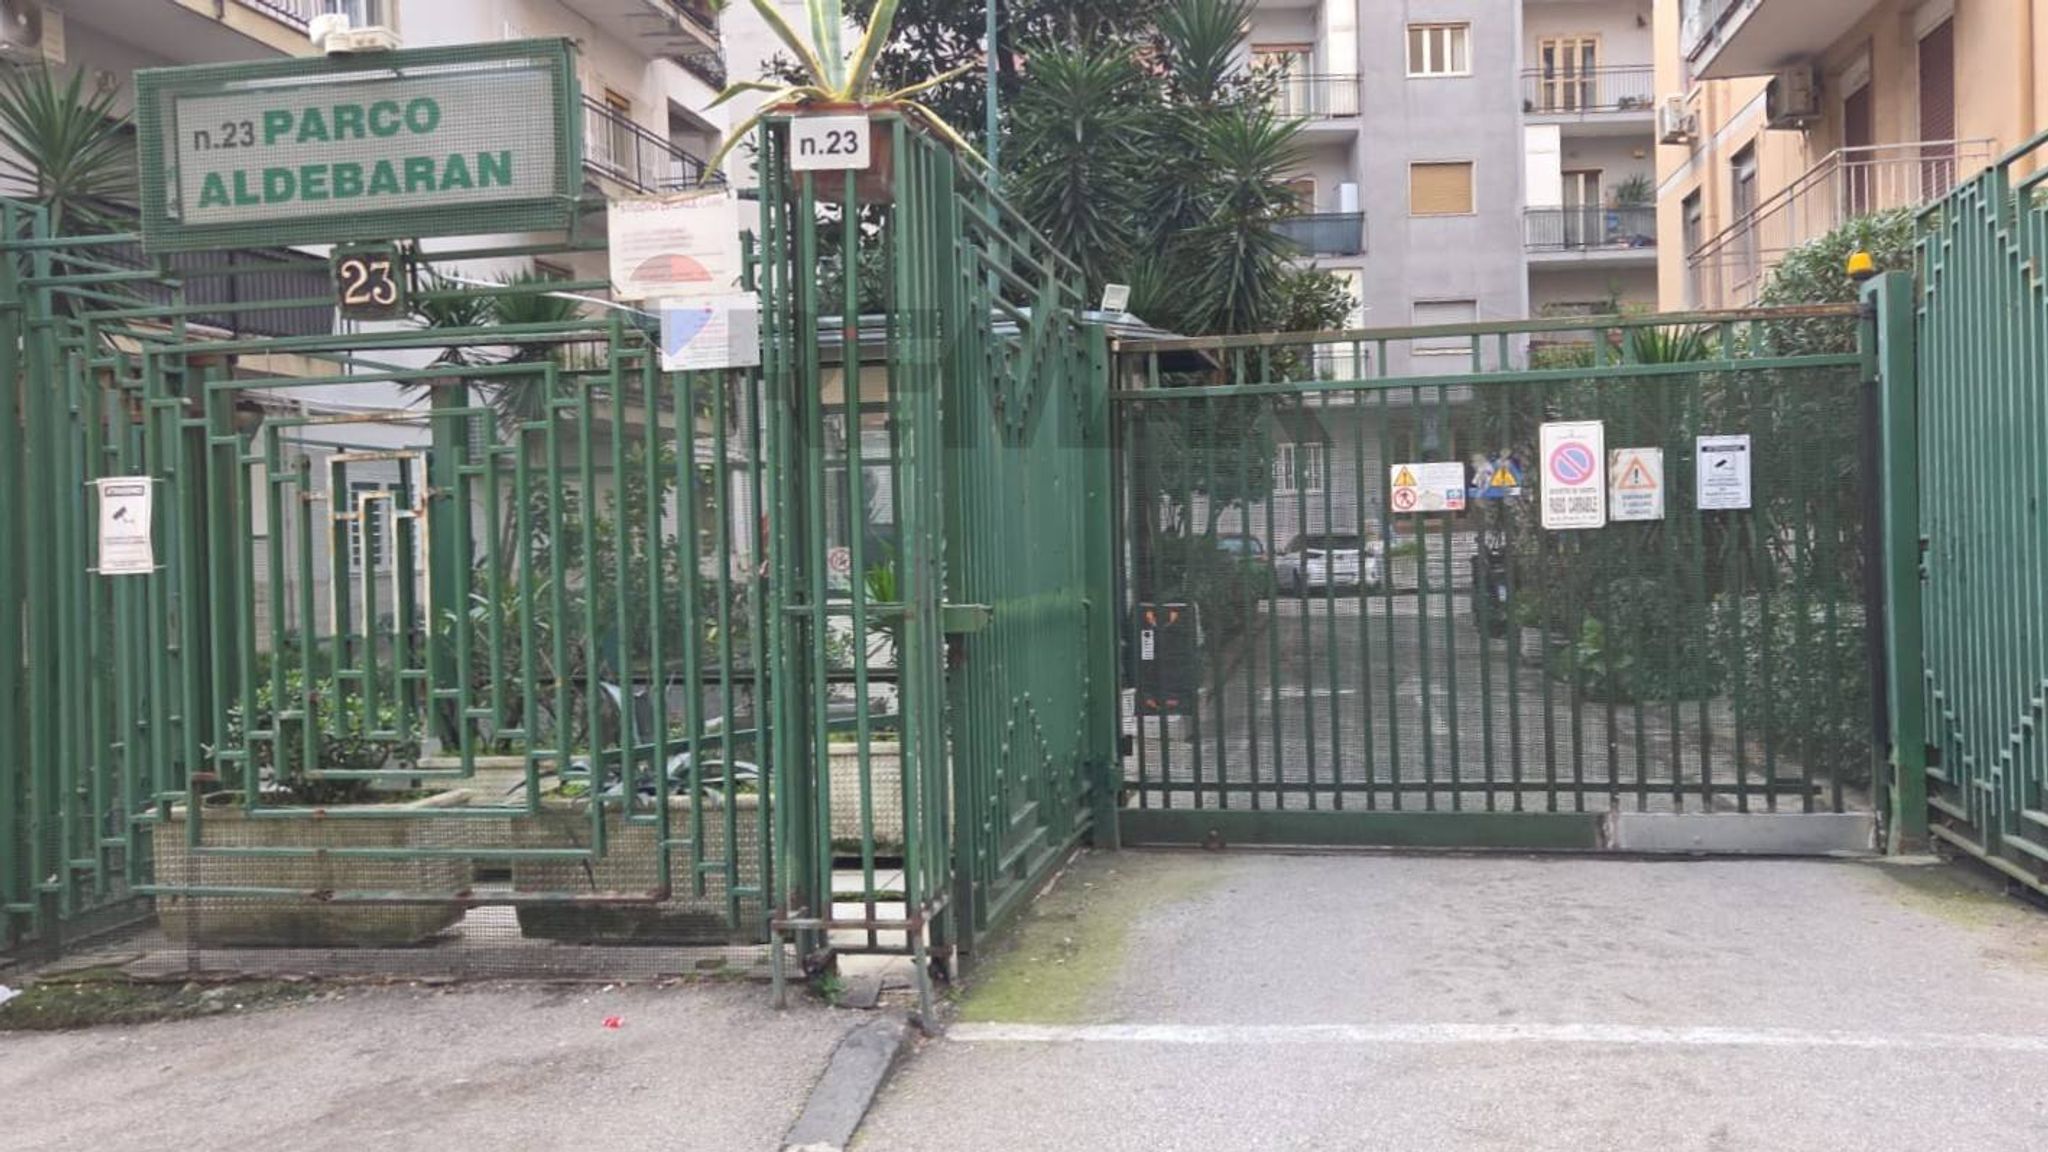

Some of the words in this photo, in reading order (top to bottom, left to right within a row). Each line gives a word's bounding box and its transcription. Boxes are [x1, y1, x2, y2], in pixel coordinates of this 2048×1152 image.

[194, 120, 255, 151] n.23
[263, 97, 441, 146] PARCO
[800, 129, 858, 155] n.23
[198, 149, 513, 208] ALDEBARAN
[340, 259, 398, 305] 23
